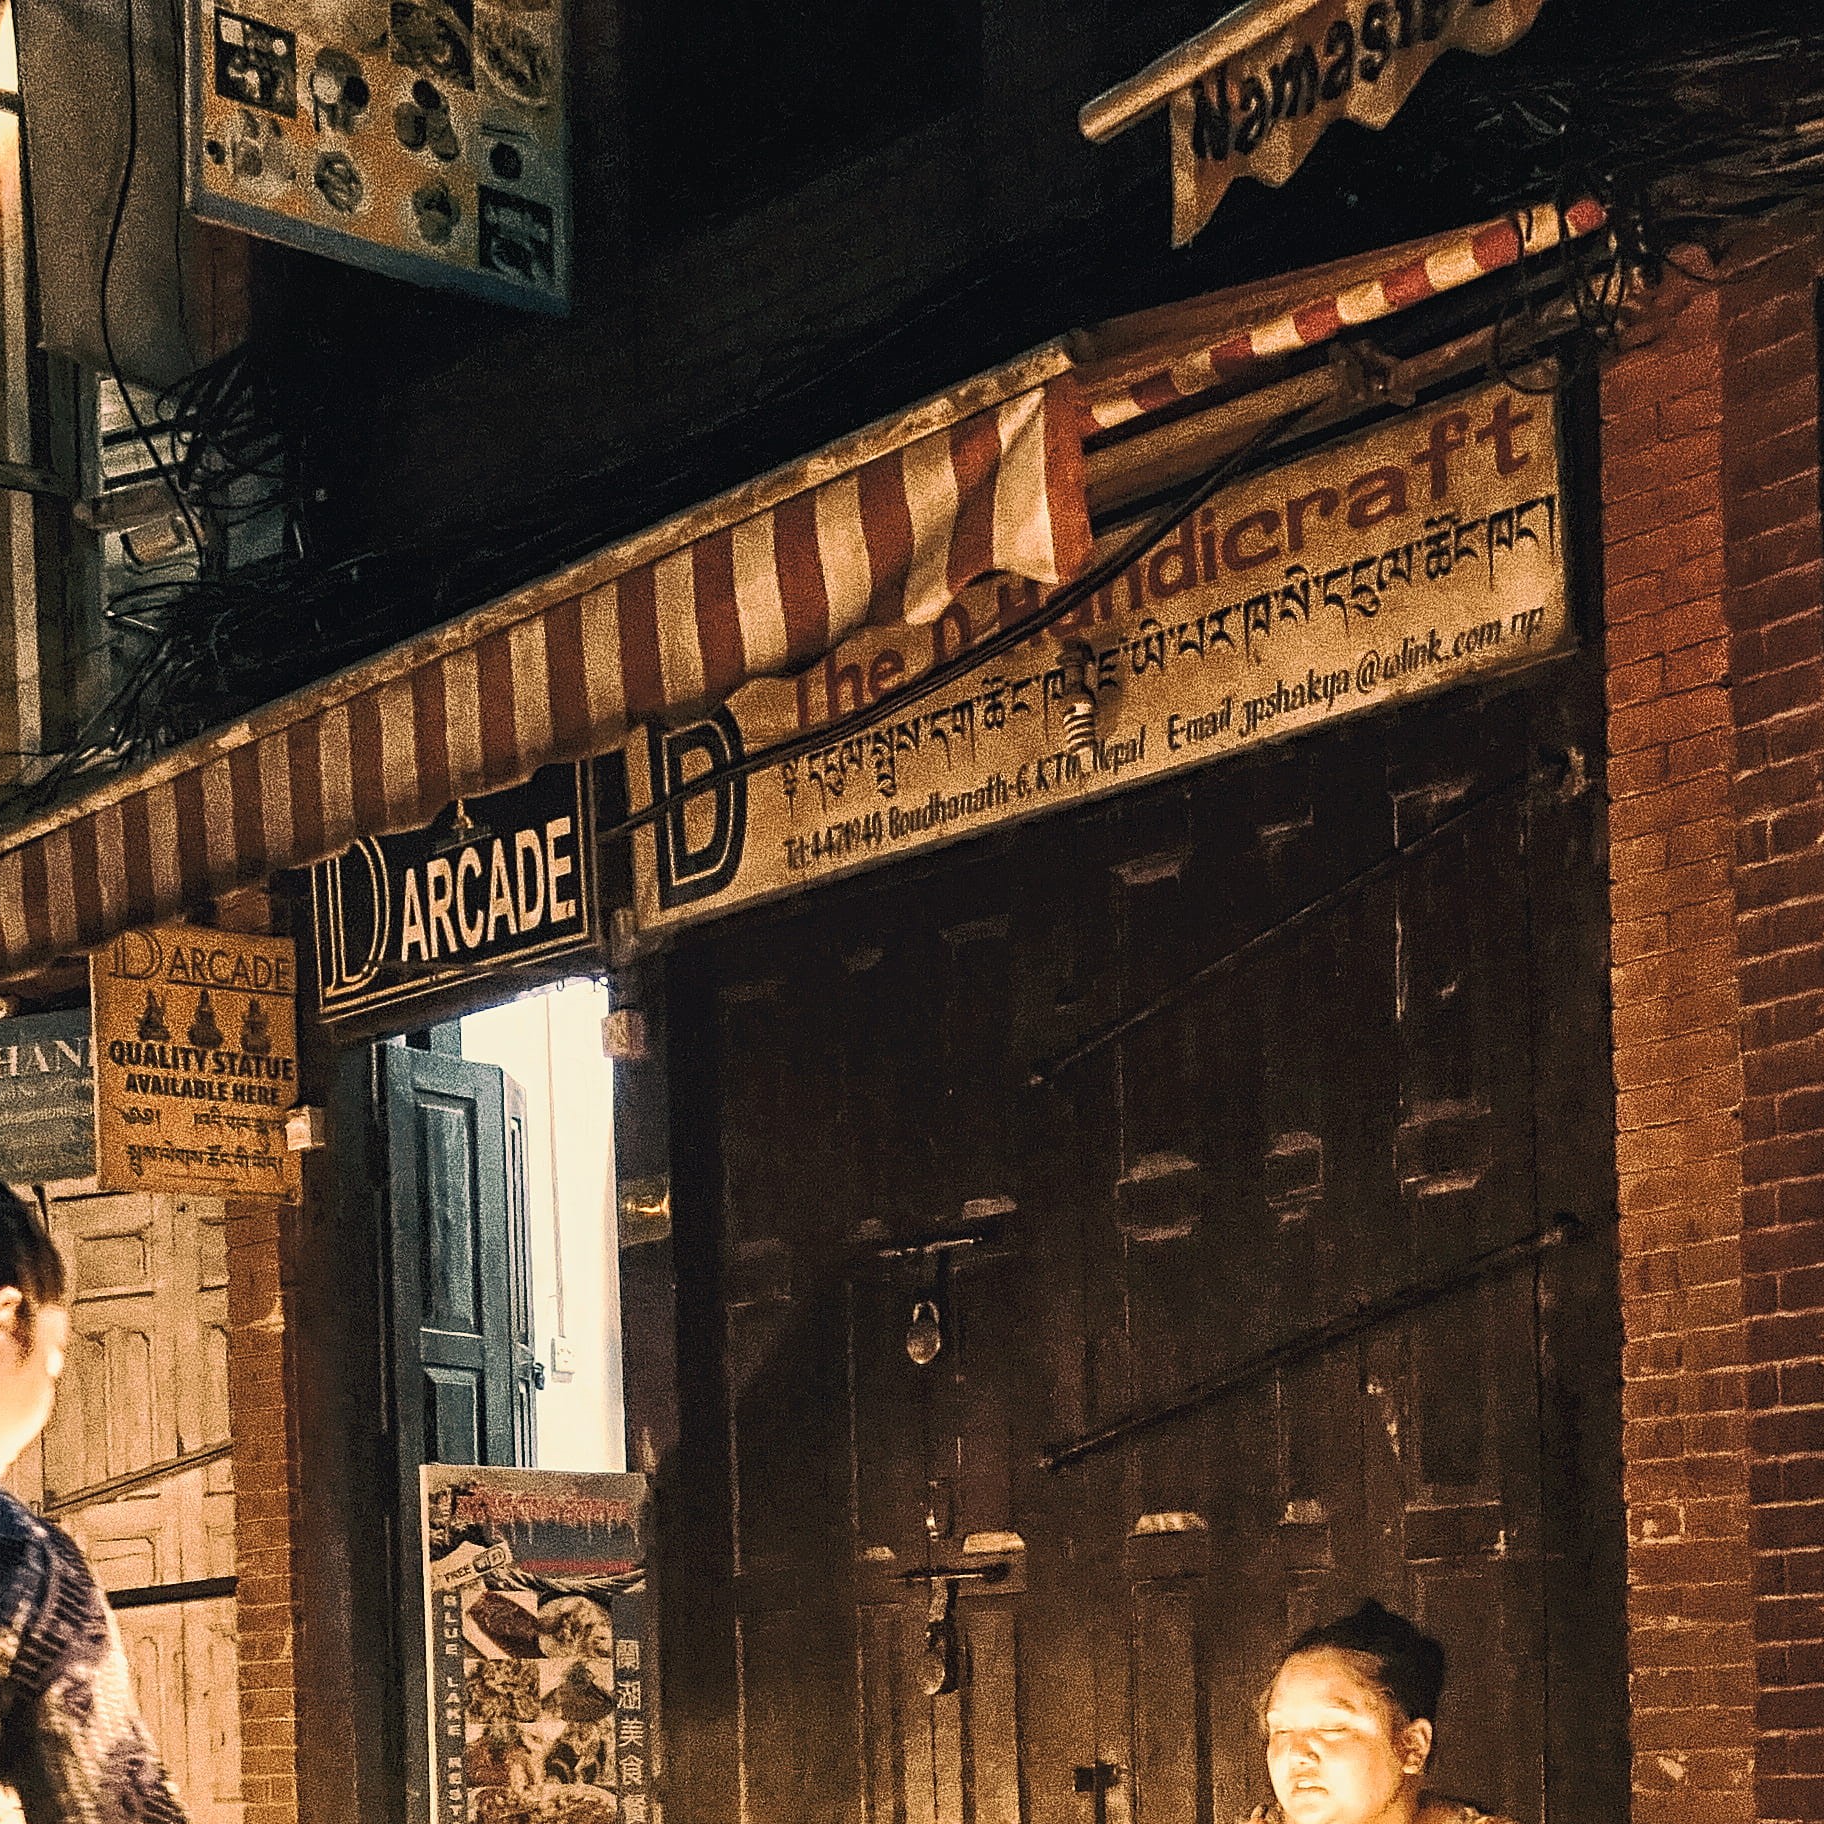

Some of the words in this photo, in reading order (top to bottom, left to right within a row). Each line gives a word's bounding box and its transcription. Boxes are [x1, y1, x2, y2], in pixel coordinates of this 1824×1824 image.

[399, 814, 578, 965] ARCADE
[167, 946, 293, 994] ARCADE
[108, 1040, 208, 1075] QUALITY
[211, 1050, 294, 1081] STATUE
[125, 1073, 228, 1101] AVAILABLE
[231, 1081, 280, 1106] HERE
[446, 1675, 463, 1737] LAKE
